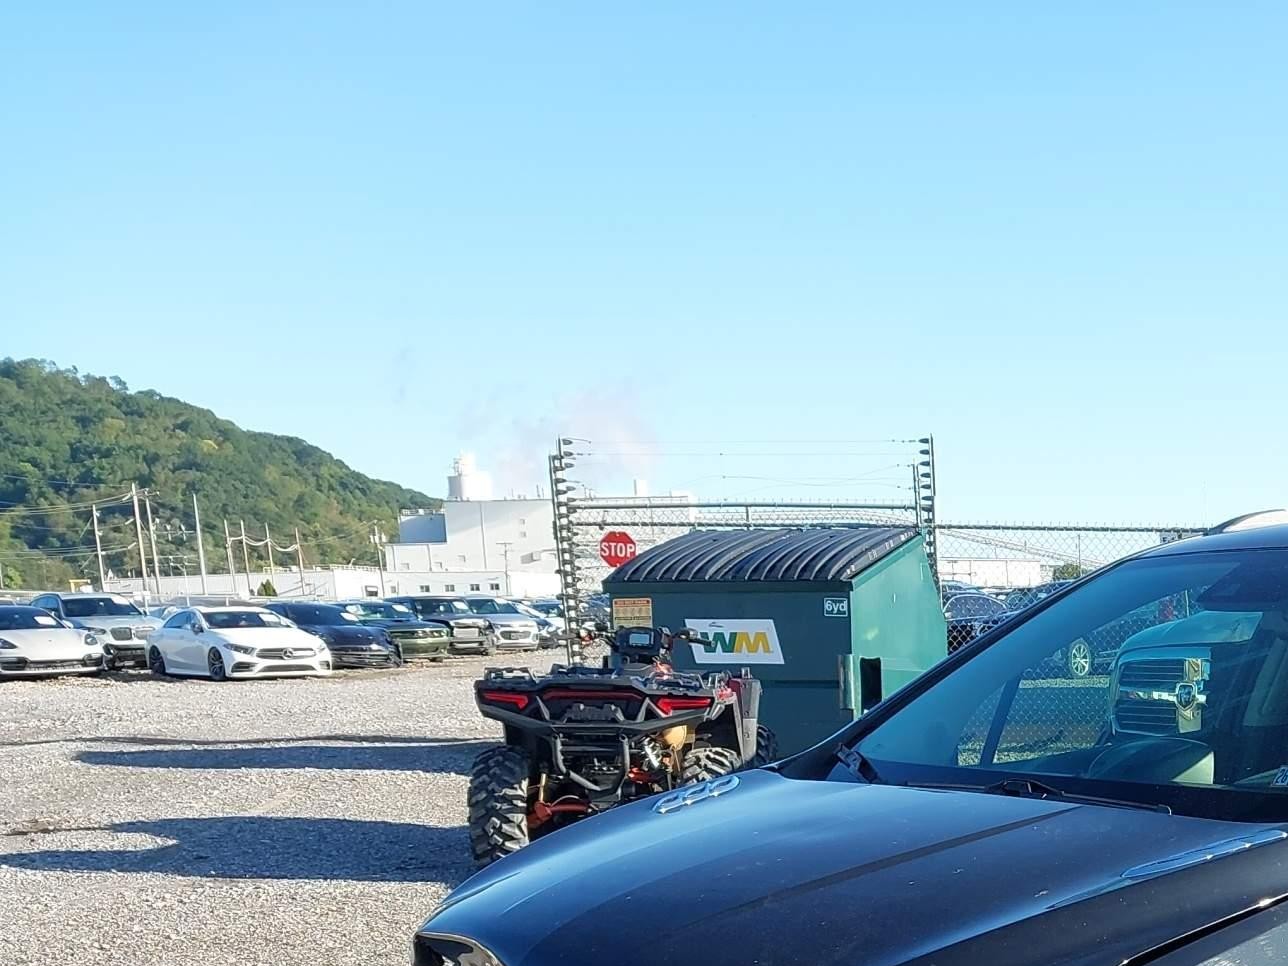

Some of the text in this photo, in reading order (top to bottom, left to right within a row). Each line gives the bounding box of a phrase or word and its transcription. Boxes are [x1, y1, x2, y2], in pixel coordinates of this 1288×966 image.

[601, 542, 635, 557] STOP
[825, 600, 847, 614] 6yd
[700, 632, 770, 653] WM
